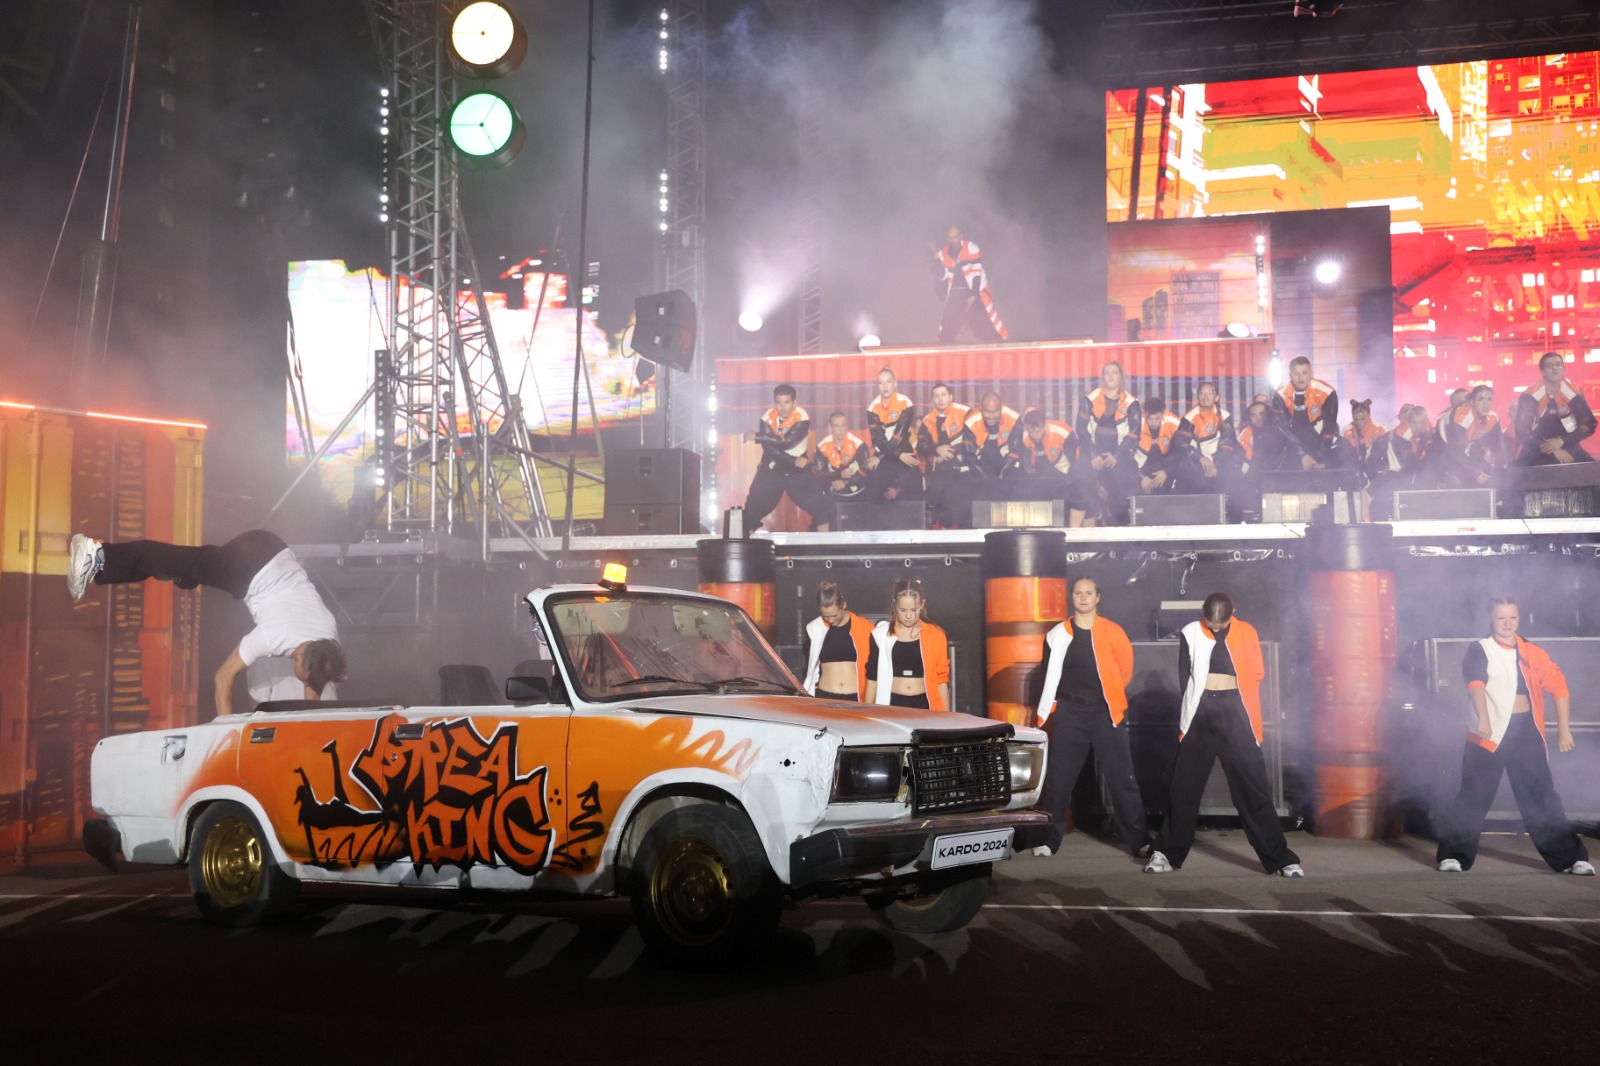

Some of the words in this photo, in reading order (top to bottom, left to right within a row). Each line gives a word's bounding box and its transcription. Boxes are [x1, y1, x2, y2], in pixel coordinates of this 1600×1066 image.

[406, 774, 553, 871] KING
[938, 843, 981, 859] KARDO
[982, 839, 1008, 852] 2024
